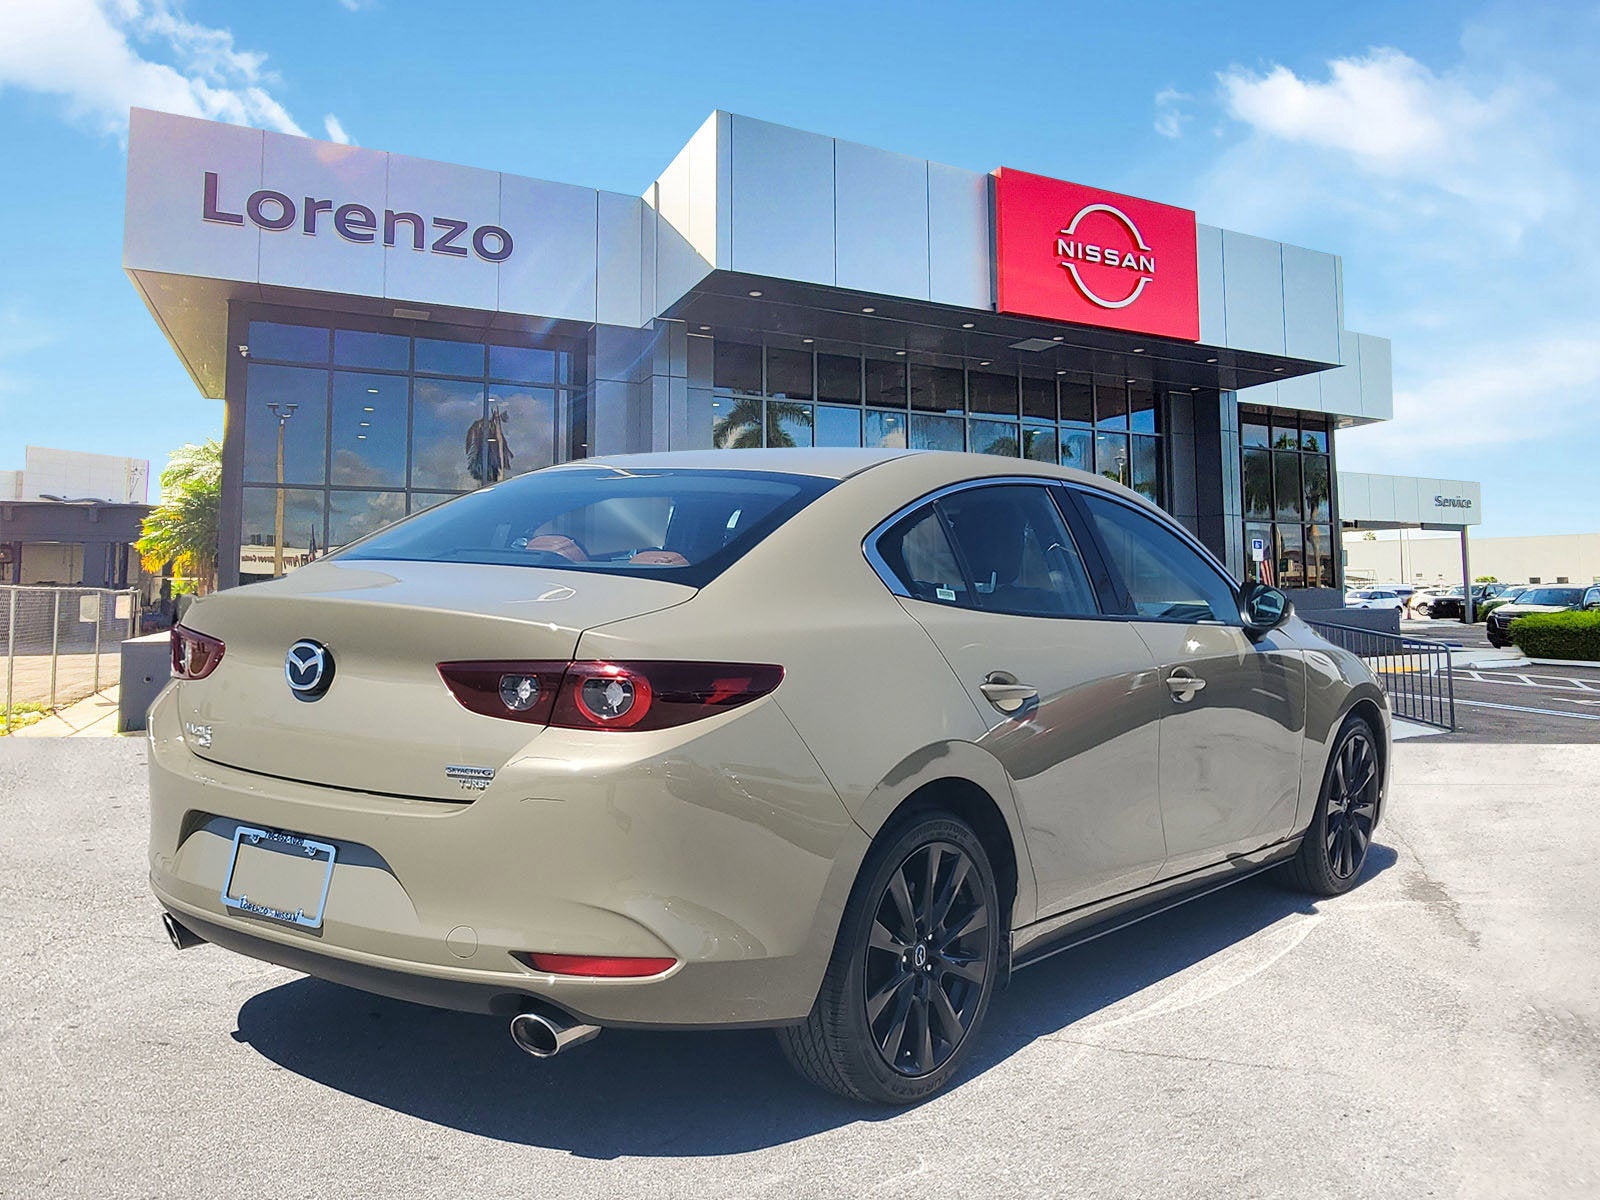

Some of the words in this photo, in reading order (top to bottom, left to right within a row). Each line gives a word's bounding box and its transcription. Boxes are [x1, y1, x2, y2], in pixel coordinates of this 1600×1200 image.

[202, 171, 514, 262] Lorenzo
[1057, 238, 1155, 273] NISSAN
[1434, 495, 1472, 508] Service
